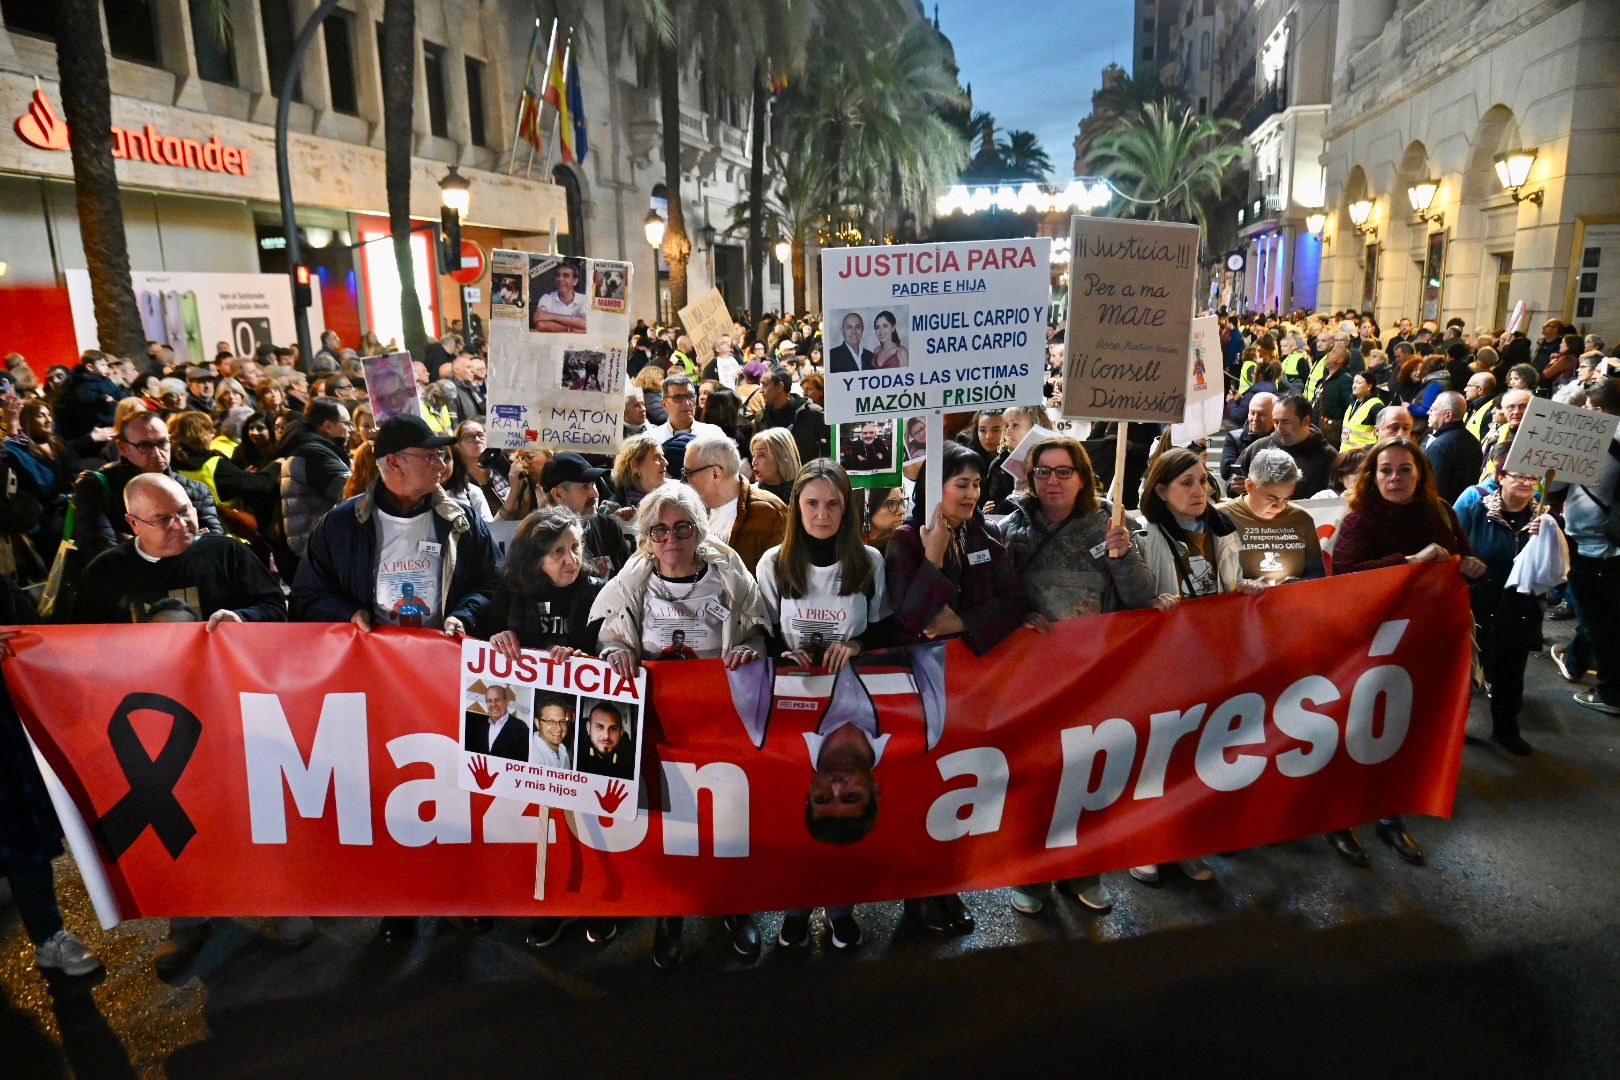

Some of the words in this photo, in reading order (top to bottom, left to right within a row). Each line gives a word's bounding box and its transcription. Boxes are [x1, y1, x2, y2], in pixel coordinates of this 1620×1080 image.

[110, 123, 251, 176] antander
[838, 250, 960, 279] JUSTICIA
[967, 246, 1036, 271] PARA
[892, 281, 939, 296] PADRE
[943, 281, 952, 293] E
[956, 278, 987, 292] HIJA
[1084, 272, 1116, 297] Per
[1121, 284, 1135, 297] a
[1140, 284, 1169, 298] ma
[597, 298, 622, 308] MAMBO
[1098, 303, 1167, 327] mare
[912, 311, 969, 331] MIGUEL
[973, 309, 1030, 327] CARPIO
[1033, 307, 1043, 323] Y
[926, 337, 968, 354] SARA
[971, 330, 1027, 350] CARPIO
[843, 377, 854, 391] Y
[858, 373, 914, 391] TODAS
[920, 369, 951, 385] LAS
[956, 363, 1029, 382] VICTIMAS
[855, 389, 926, 413] MAZÓN
[943, 382, 1016, 406] PRISIÓN
[569, 422, 585, 430] AL
[1541, 426, 1601, 455] JUSTICIA
[1519, 447, 1600, 477] ASESINOS
[1271, 542, 1285, 550] NO
[806, 608, 847, 621] PRESÓ
[466, 647, 640, 699] JUSTICIA
[239, 692, 750, 858] Man
[926, 746, 1009, 842] a
[1045, 619, 1414, 849] presó
[505, 761, 526, 773] por
[528, 766, 543, 776] mi
[547, 770, 589, 784] marido
[514, 777, 522, 788] y
[525, 780, 546, 792] mis
[549, 783, 578, 797] hijos
